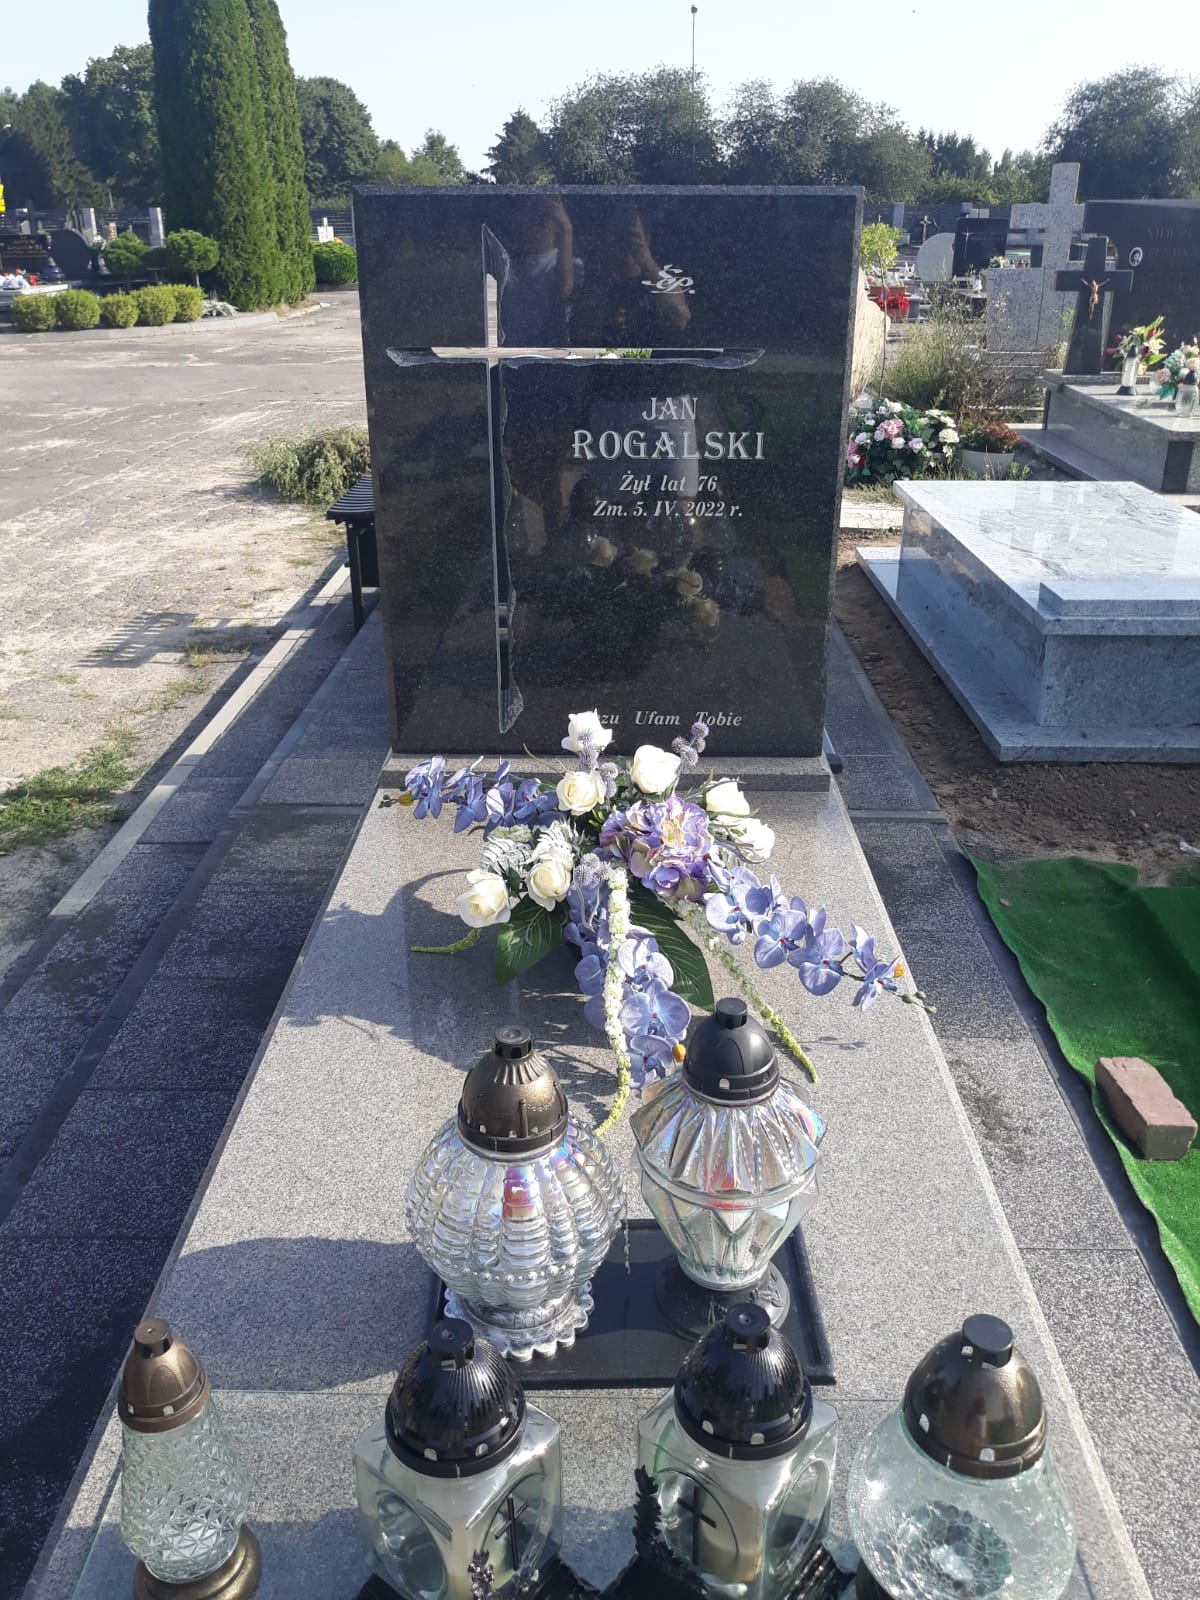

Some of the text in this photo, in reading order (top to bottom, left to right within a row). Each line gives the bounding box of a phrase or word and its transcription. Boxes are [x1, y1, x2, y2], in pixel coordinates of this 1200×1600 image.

[642, 397, 698, 420] JAN
[571, 429, 765, 460] ROGALSKI
[619, 470, 718, 494] Żył lat 76
[593, 500, 743, 516] Zm. 5. IV. 2022 r.
[635, 710, 680, 726] Ufam
[695, 711, 743, 726] Tobie
